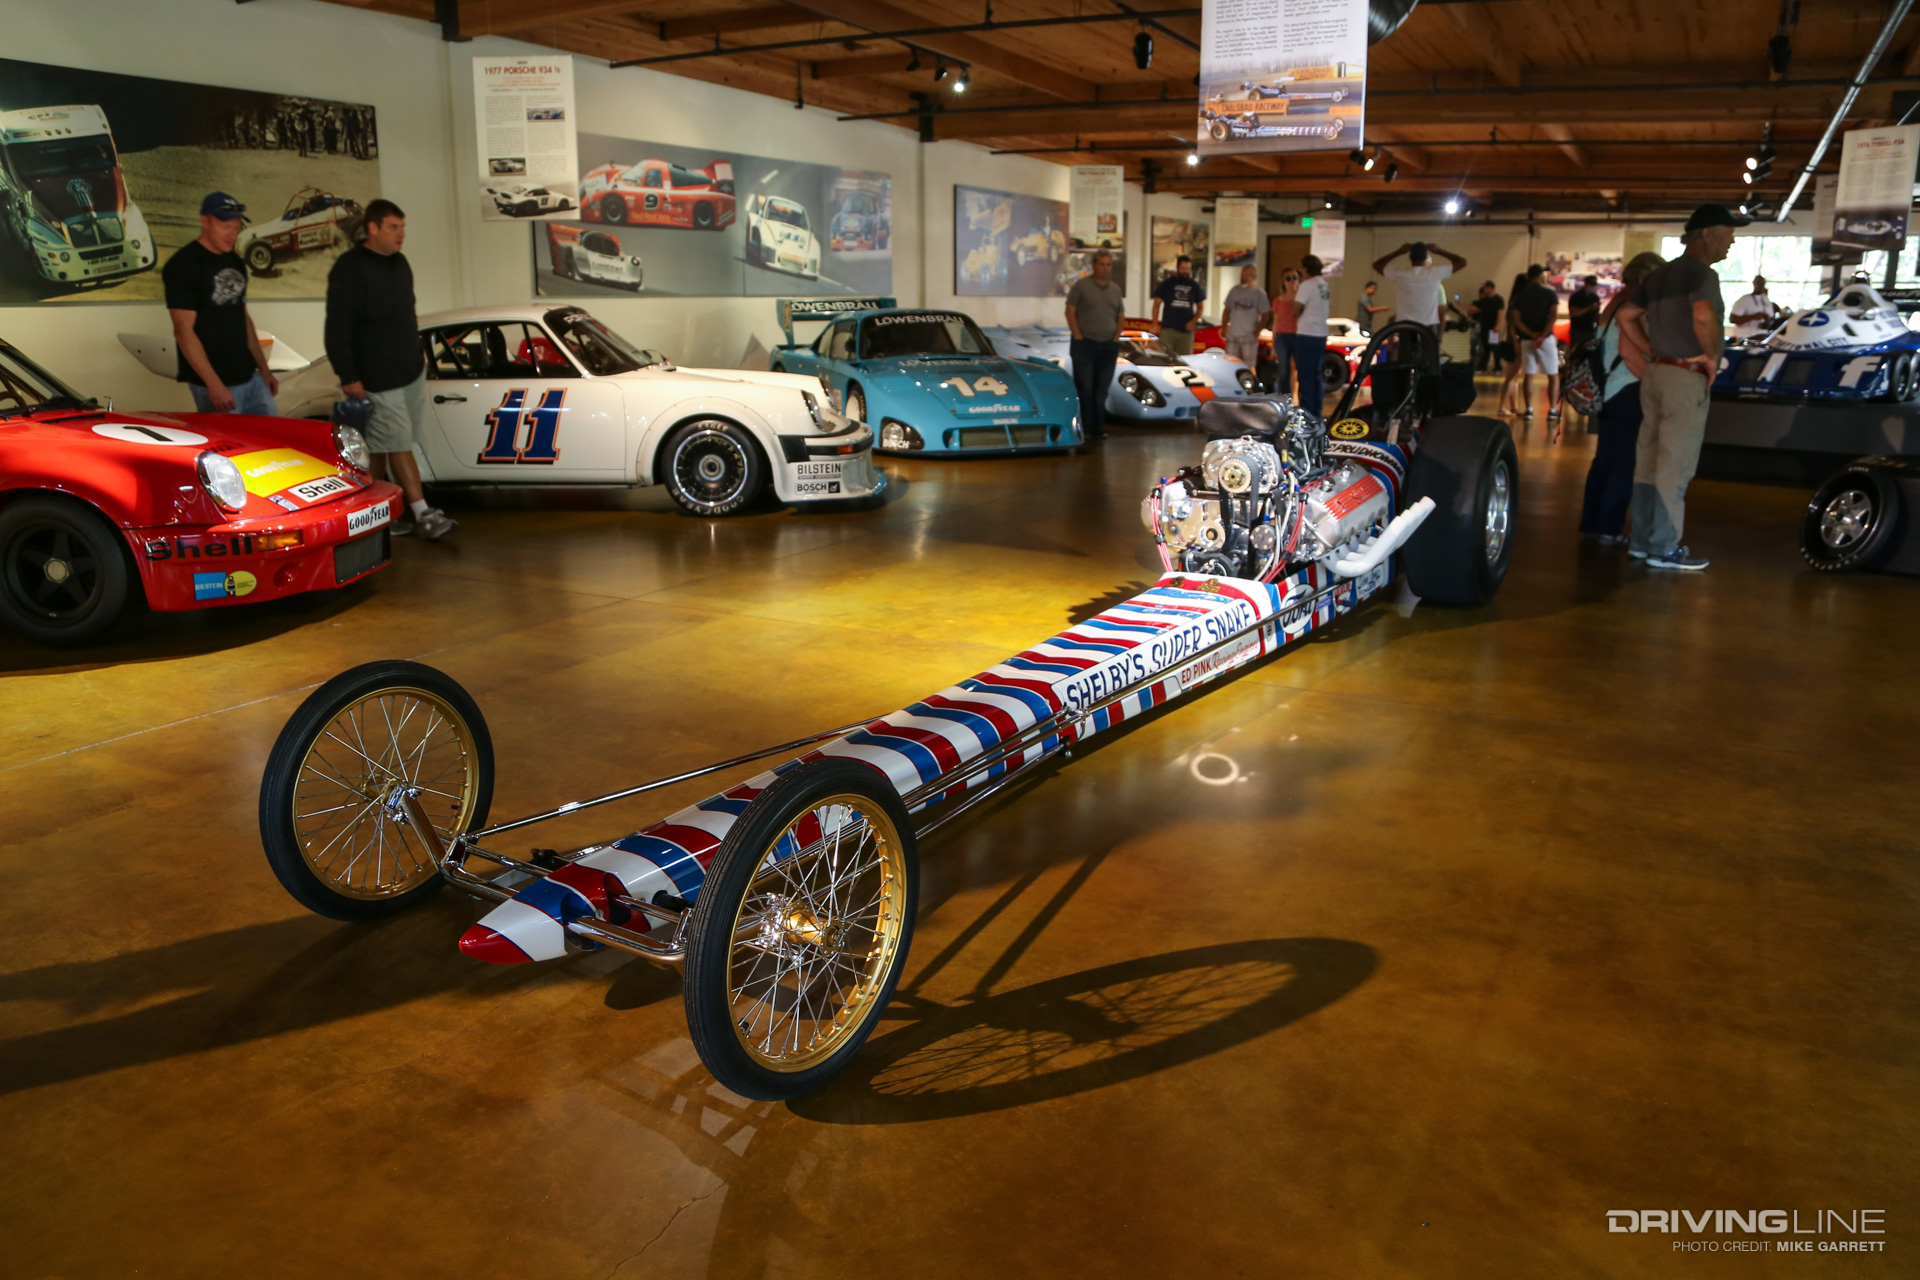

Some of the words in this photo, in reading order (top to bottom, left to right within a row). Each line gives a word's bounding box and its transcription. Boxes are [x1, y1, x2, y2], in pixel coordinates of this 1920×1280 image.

[485, 67, 501, 75] 1977
[503, 66, 537, 74] PORSCHE
[538, 65, 553, 73] 934
[1221, 102, 1254, 112] CARLSBAD
[1255, 100, 1286, 111] RACEWAY
[644, 192, 659, 210] 9
[943, 376, 1009, 397] 14
[1173, 369, 1206, 387] 2
[968, 403, 1021, 413] GOODYEAR
[122, 426, 174, 442] 1
[476, 387, 568, 465] 11
[882, 438, 910, 449] BOSCH
[797, 463, 841, 475] BILSTEIN
[298, 477, 346, 498] Shell
[797, 482, 827, 492] BOSCH
[349, 506, 390, 530] GOODYEAR
[144, 536, 253, 562] Shell
[195, 583, 223, 591] BILSTEIN
[1066, 651, 1145, 710] SHELBY'S
[1150, 625, 1202, 673] SUPER
[1205, 603, 1251, 646] SNAKE
[1181, 669, 1192, 684] ED
[1193, 657, 1212, 679] PINK
[1212, 649, 1237, 671] Racing
